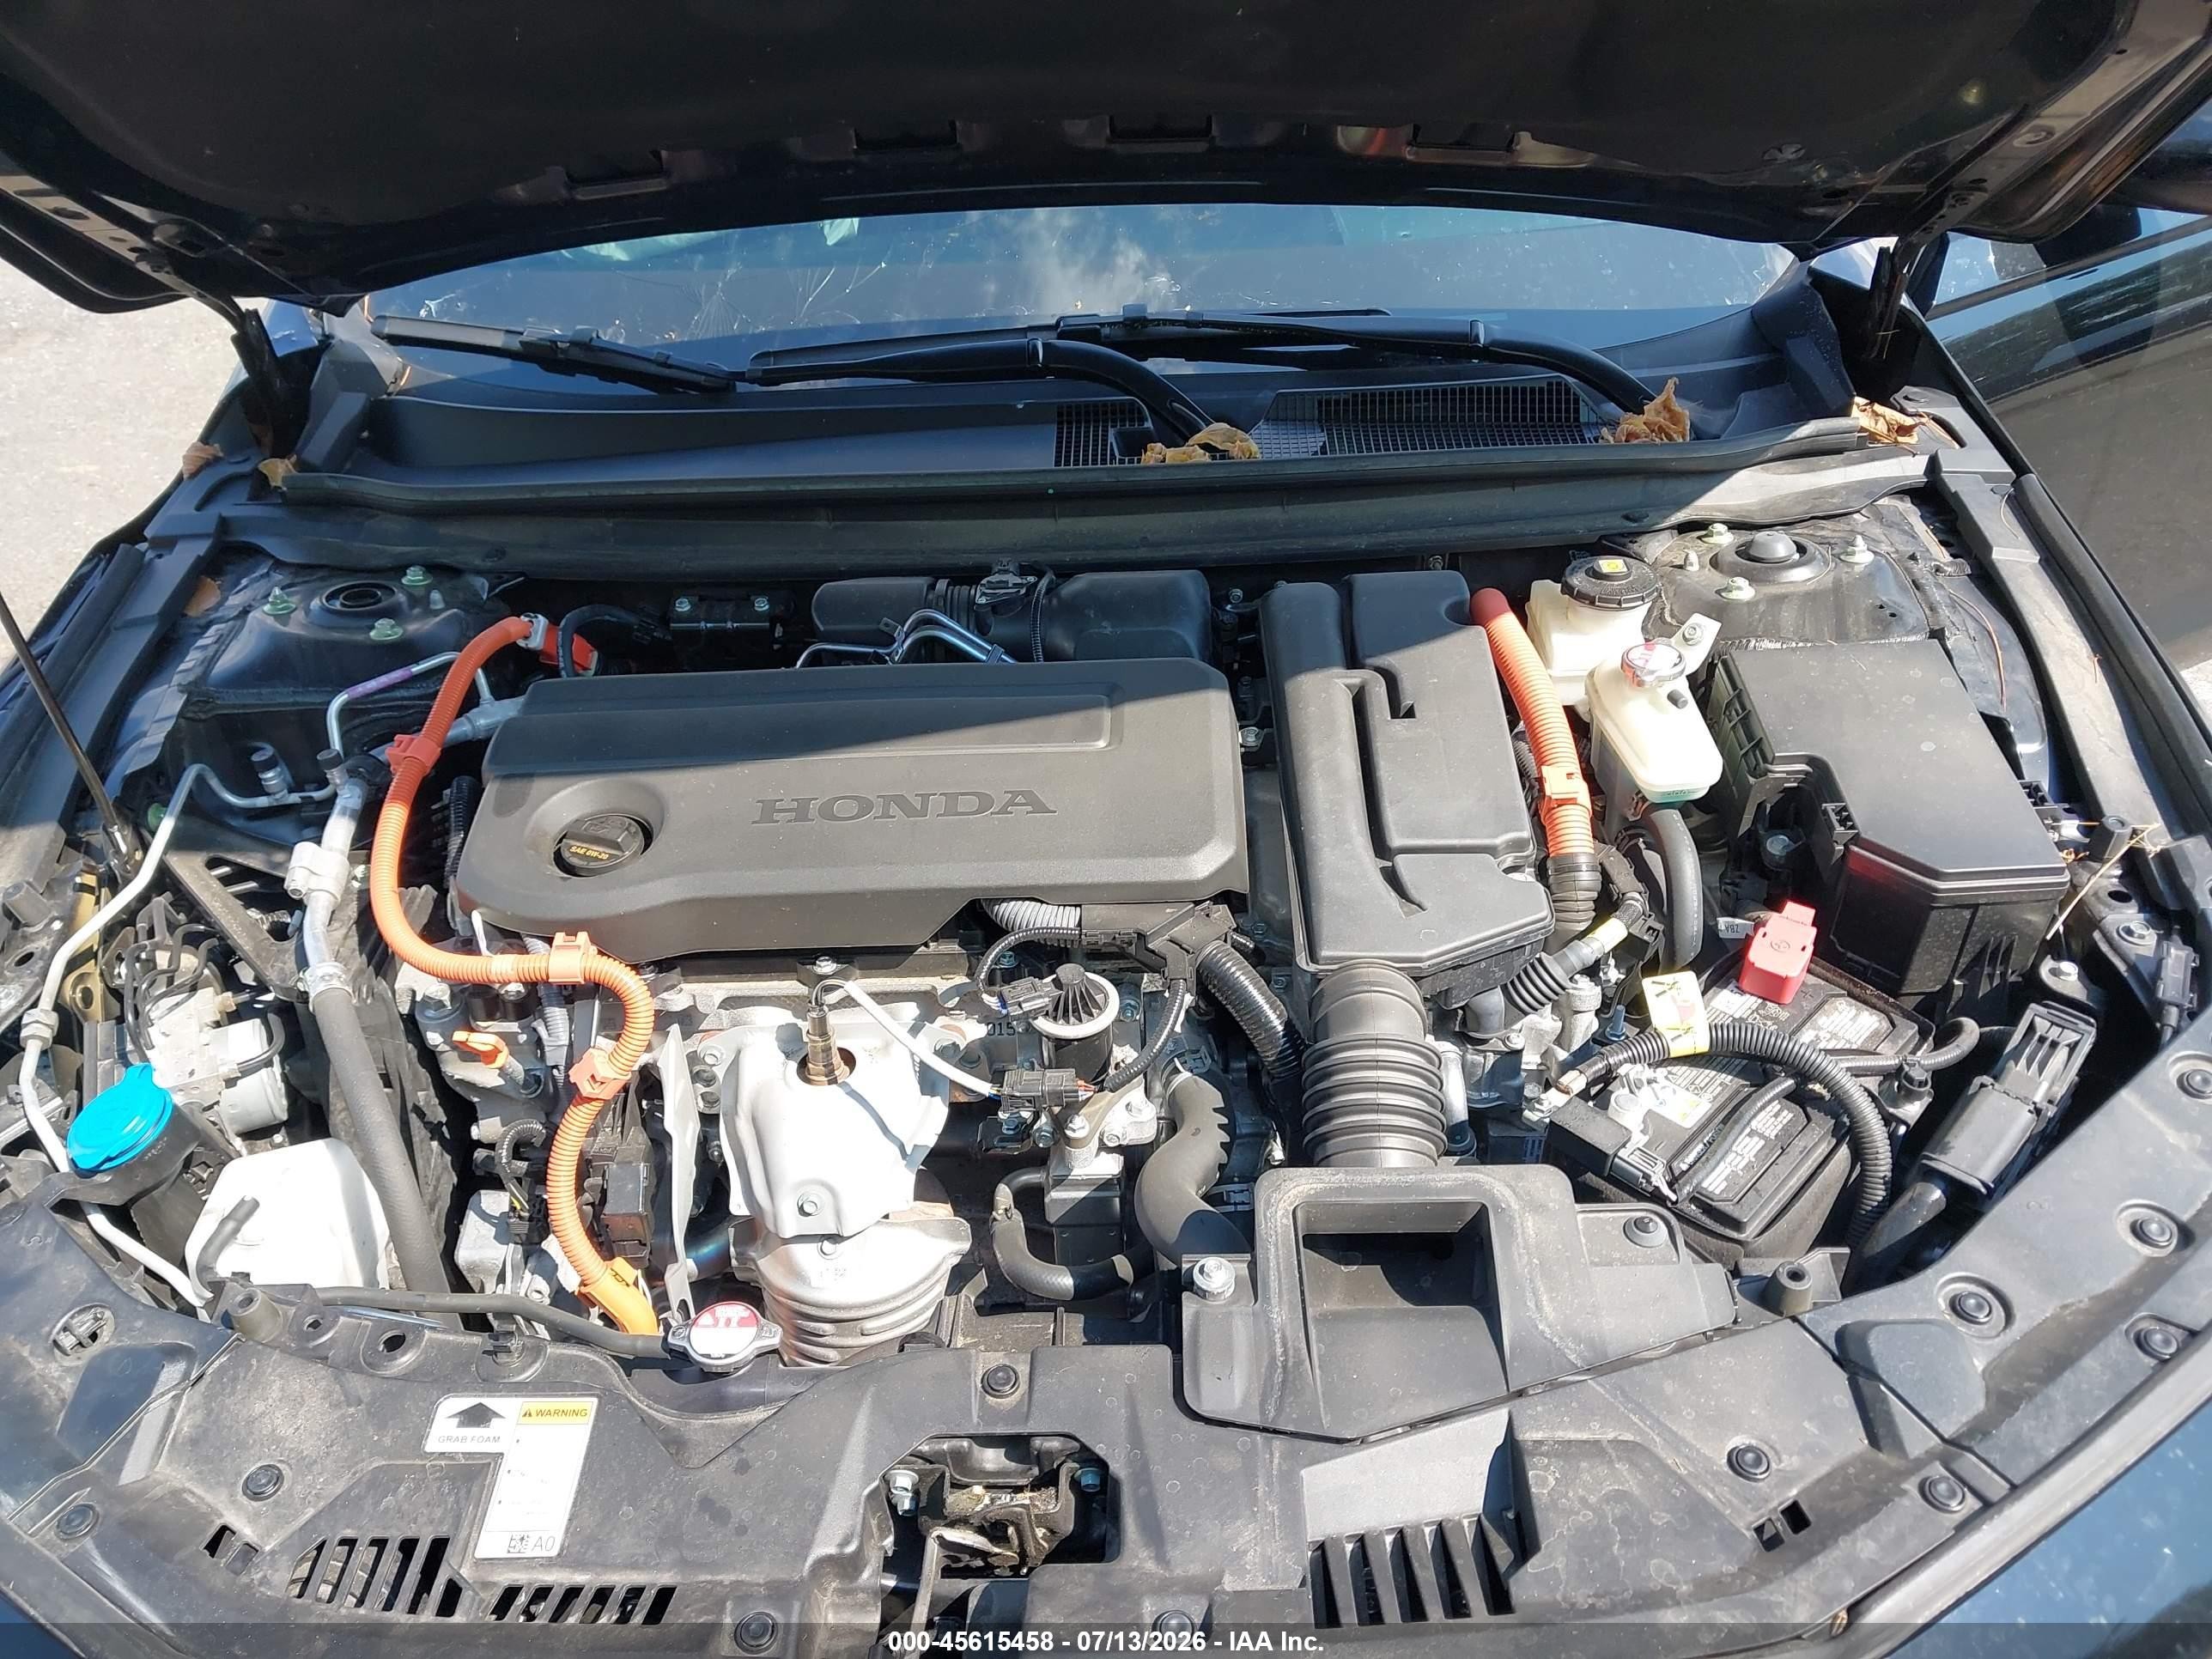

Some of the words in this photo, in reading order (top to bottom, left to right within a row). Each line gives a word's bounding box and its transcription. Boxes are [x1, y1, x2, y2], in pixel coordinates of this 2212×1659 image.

[750, 789, 1058, 825] HONDA
[569, 846, 586, 855] SAE
[586, 848, 610, 860] 0W-20
[535, 1408, 588, 1418] WARNING
